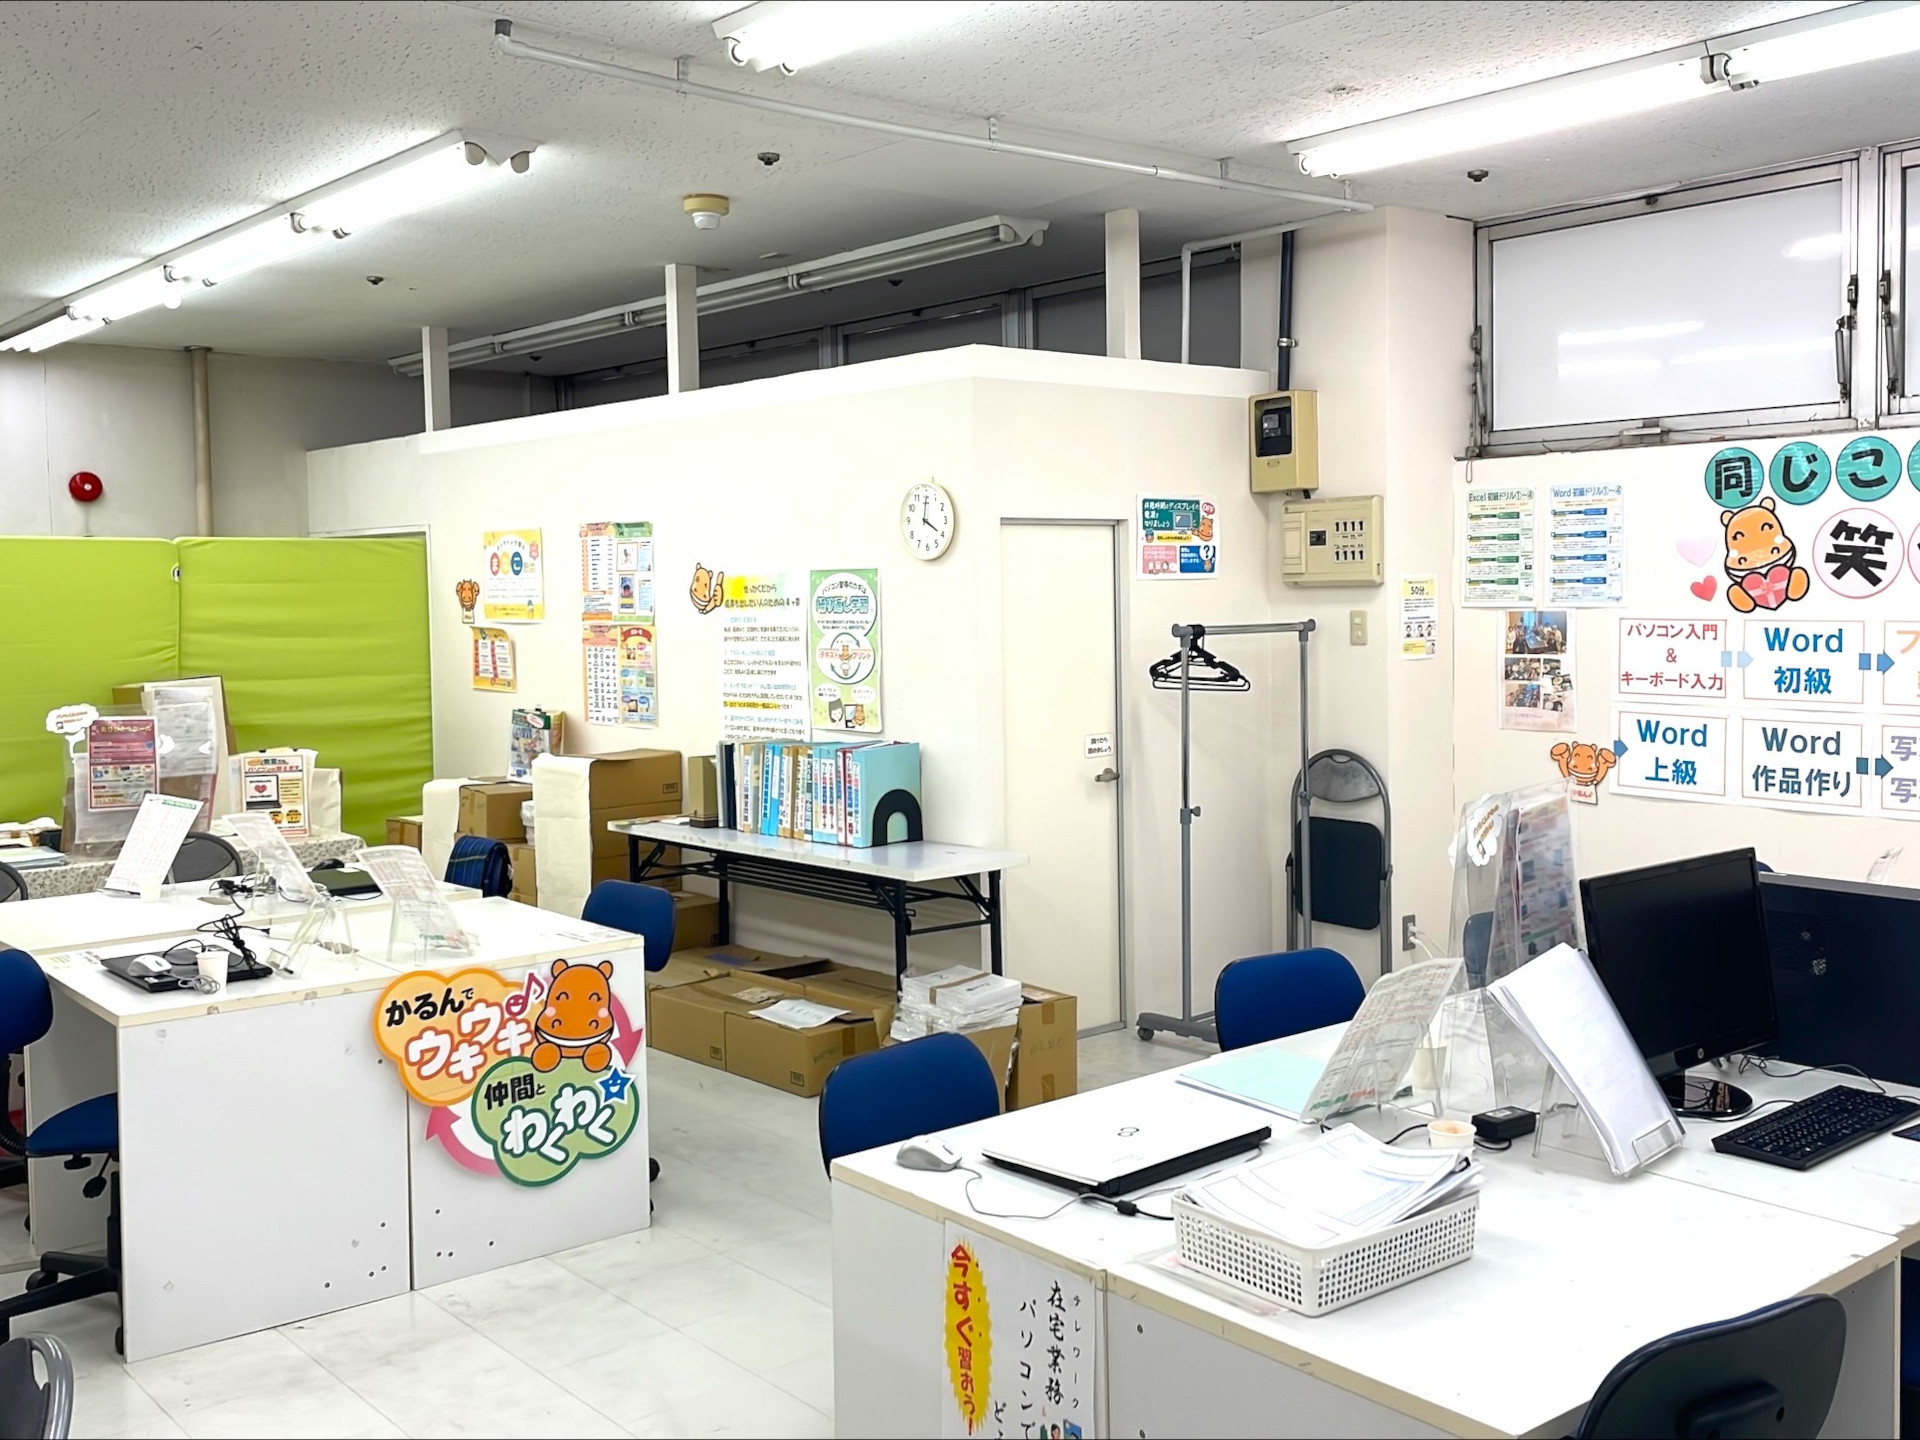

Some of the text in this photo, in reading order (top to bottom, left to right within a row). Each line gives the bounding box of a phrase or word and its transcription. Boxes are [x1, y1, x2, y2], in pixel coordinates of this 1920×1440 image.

[1468, 493, 1487, 502] Excel
[1552, 488, 1572, 498] Word
[1627, 623, 1718, 640] パソコン入門
[1764, 627, 1843, 653] Word
[1666, 647, 1677, 663] &
[1620, 671, 1723, 691] キーボード入力
[1774, 666, 1832, 694] 初級
[1636, 719, 1708, 747] Word
[1762, 727, 1841, 756] Word
[1645, 757, 1697, 785] 上級
[1752, 764, 1851, 797] 作品作り
[385, 987, 474, 1027] かるんで
[407, 1001, 533, 1081] ウキウキ
[484, 1073, 546, 1111] 仲間と
[502, 1086, 616, 1163] わくわく
[1073, 1295, 1082, 1409] テレワーク
